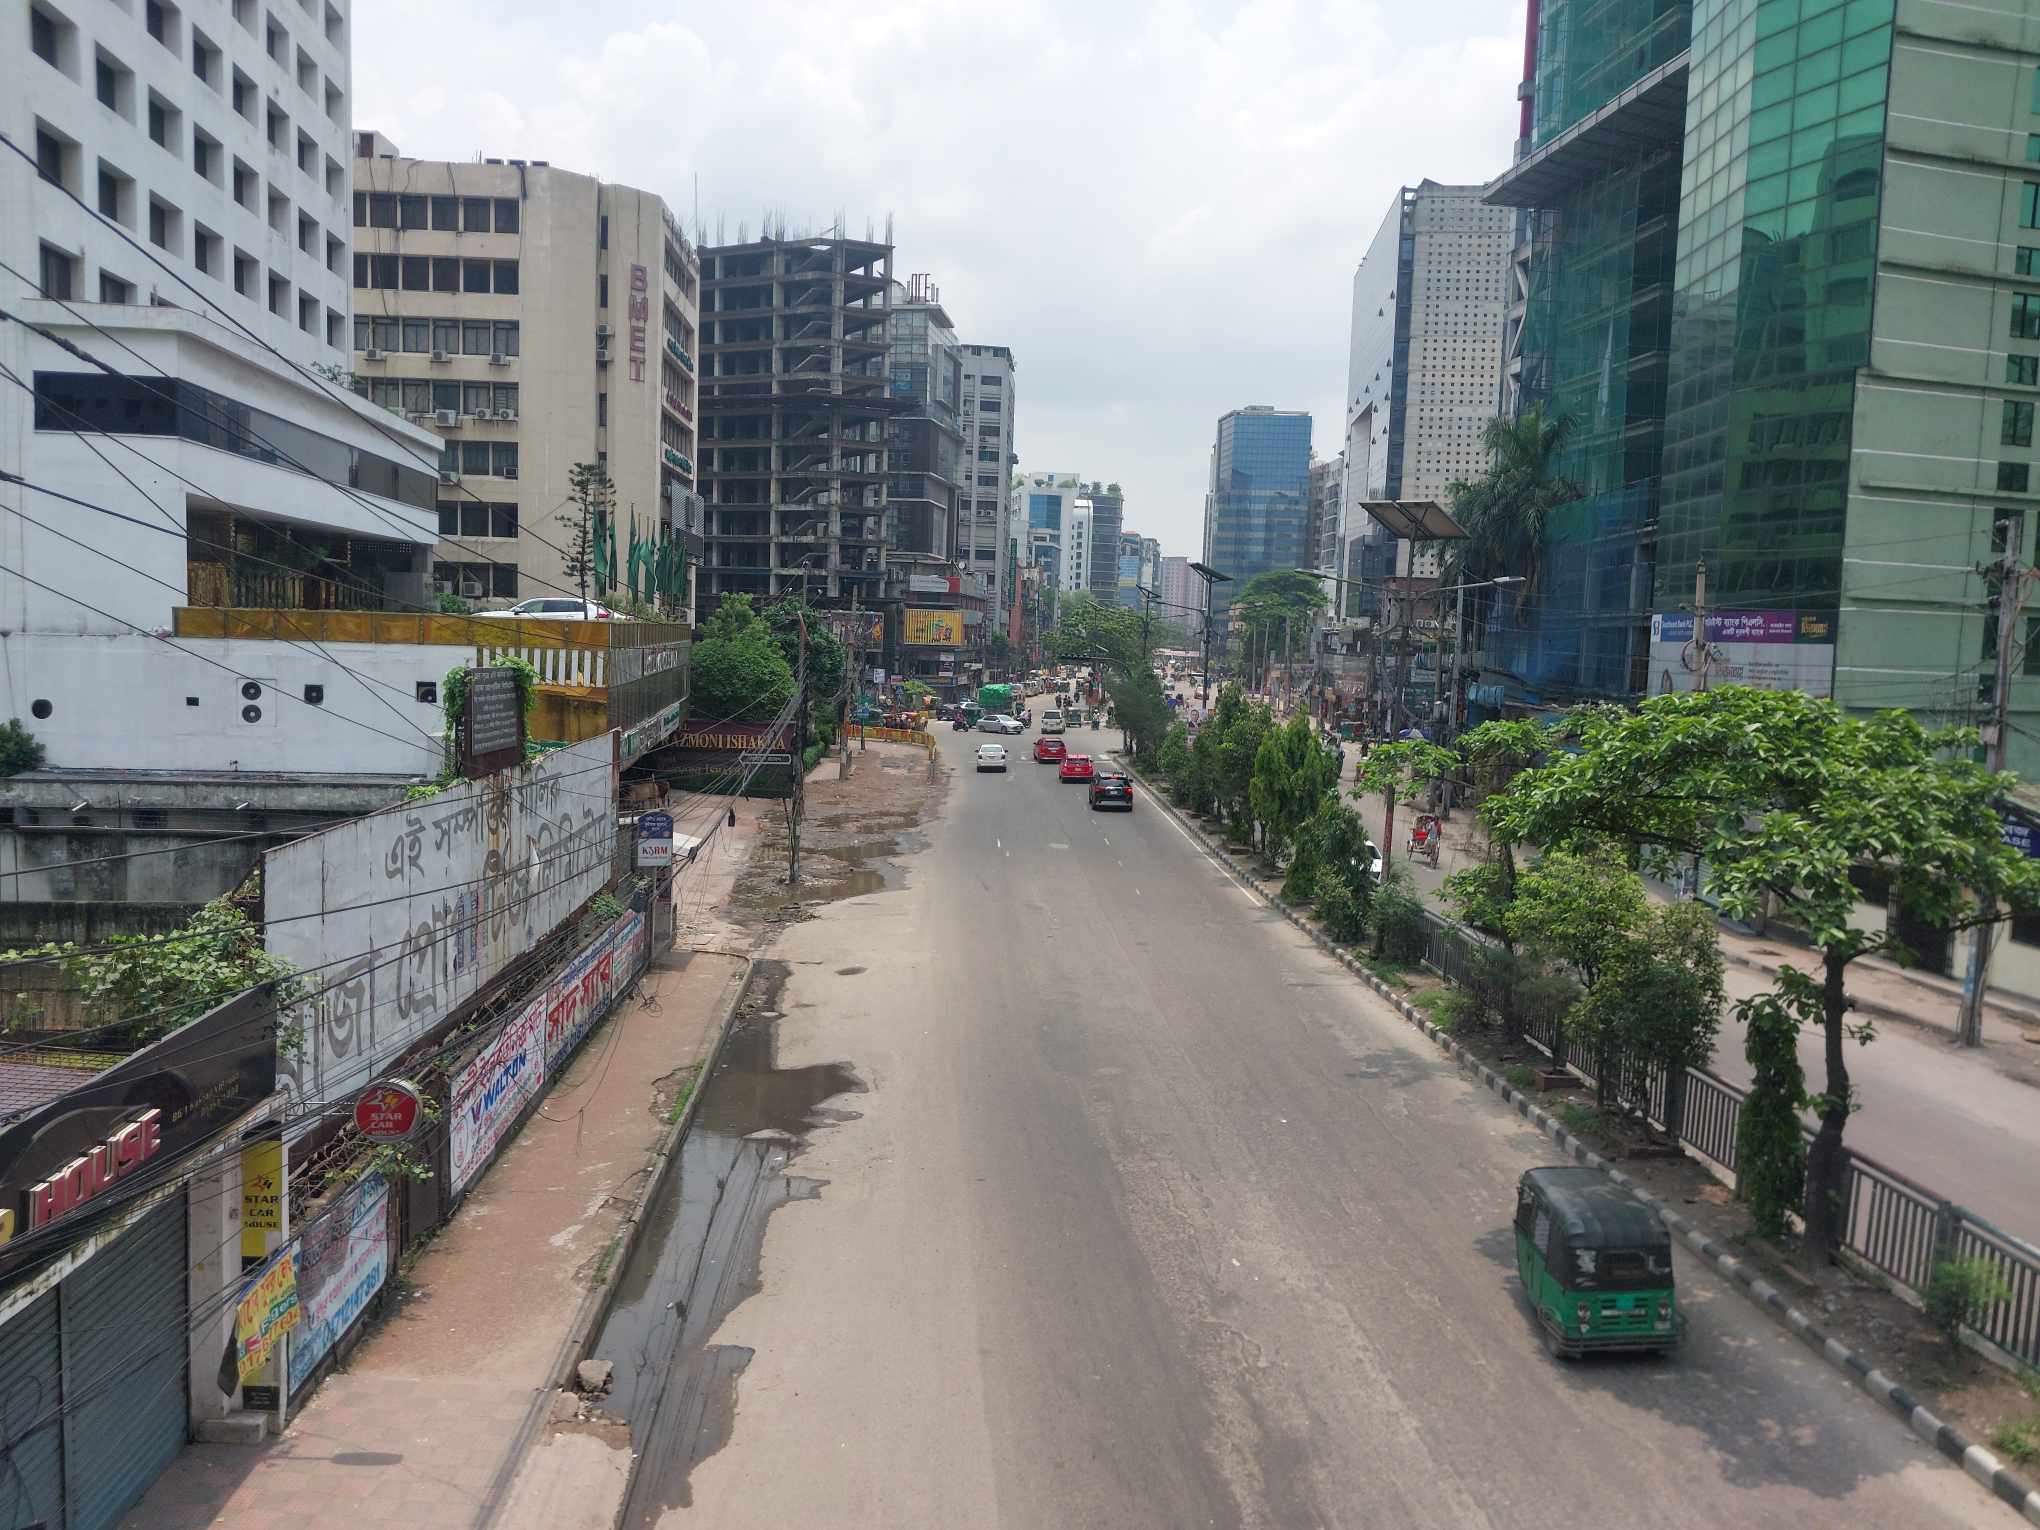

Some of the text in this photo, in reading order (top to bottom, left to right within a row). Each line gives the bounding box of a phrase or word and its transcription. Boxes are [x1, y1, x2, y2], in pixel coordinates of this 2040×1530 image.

[630, 264, 648, 381] BMET
[727, 734, 785, 750] ISHAKA
[385, 813, 426, 882] এই
[483, 1047, 527, 1112] WALTON
[370, 1113, 402, 1121] STAR
[29, 1108, 161, 1232] HOUSE
[245, 1195, 279, 1203] STAR
[249, 1209, 274, 1217] CAR
